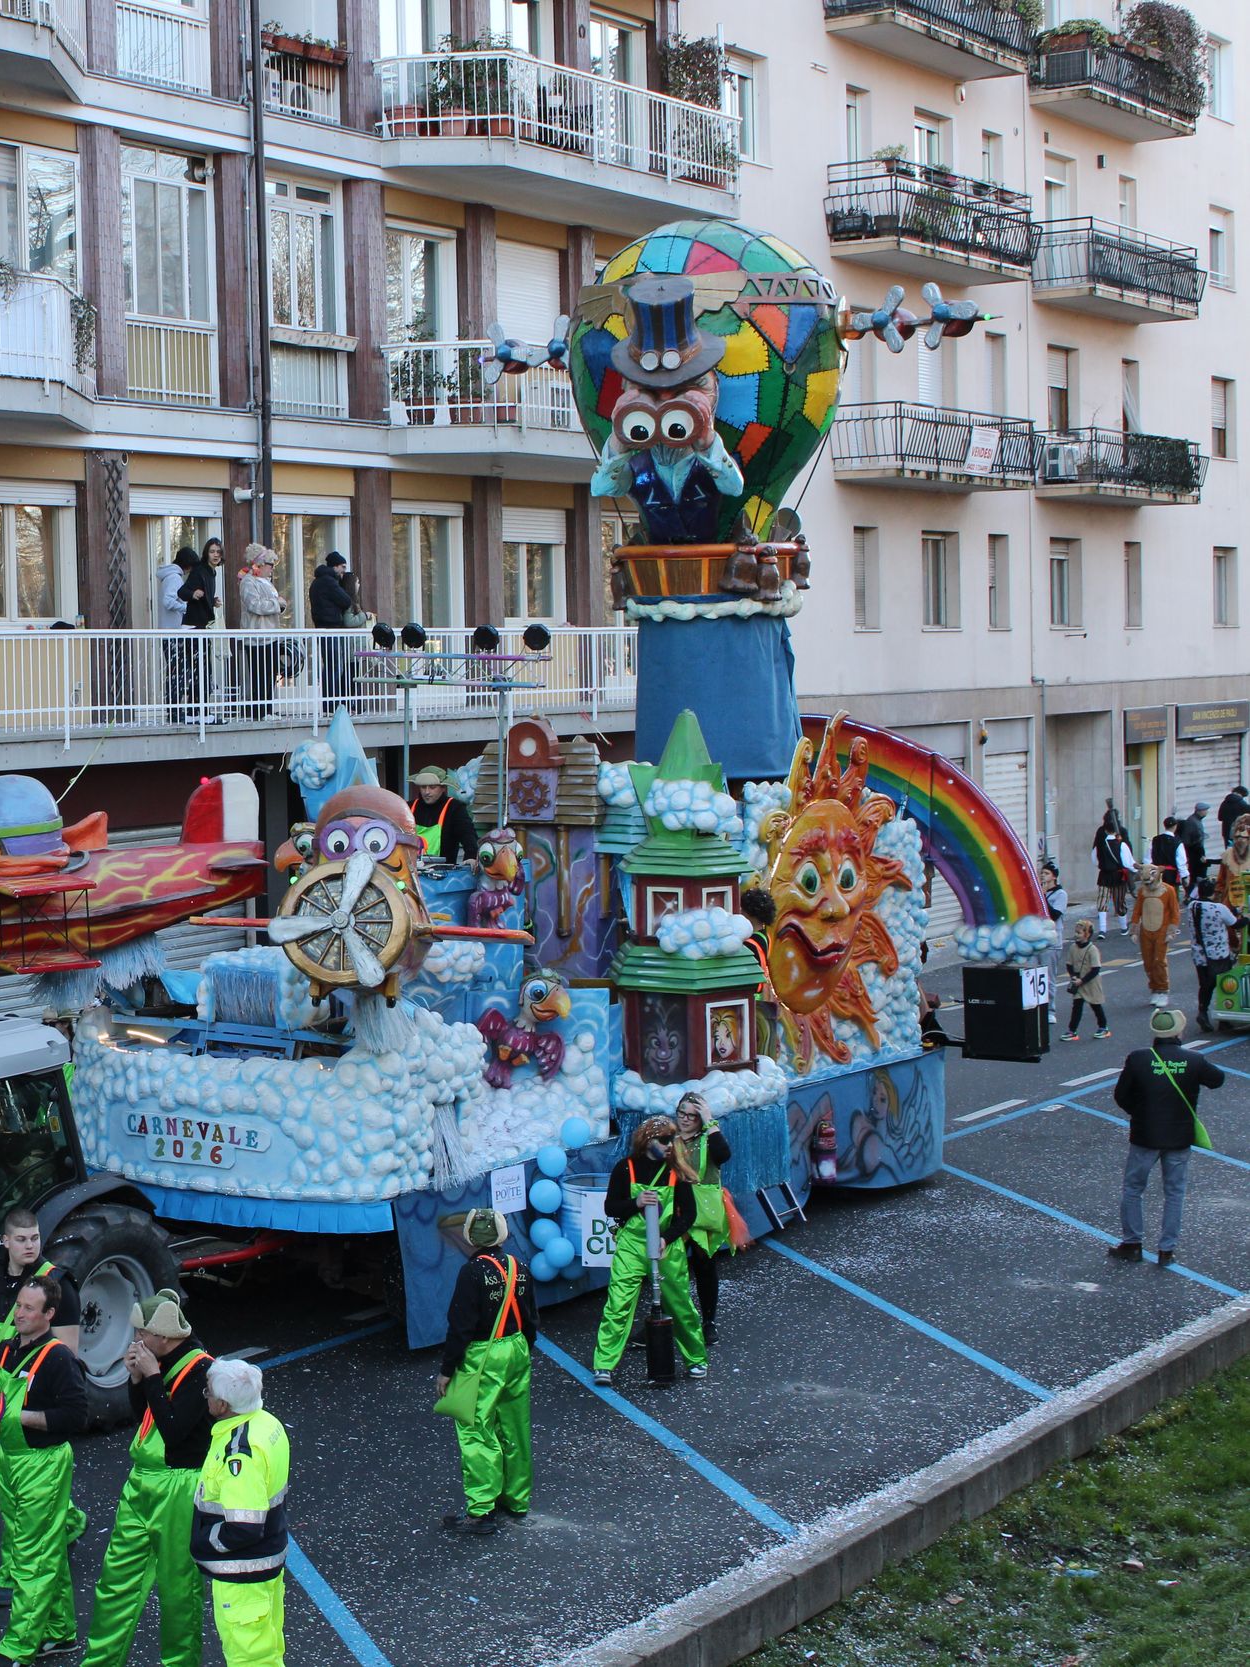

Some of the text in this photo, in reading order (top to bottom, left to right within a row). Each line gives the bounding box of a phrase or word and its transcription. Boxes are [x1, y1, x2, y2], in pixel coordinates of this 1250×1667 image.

[1029, 973, 1046, 998] 15
[127, 1113, 259, 1150] CARNEVALE
[155, 1137, 223, 1165] 2026
